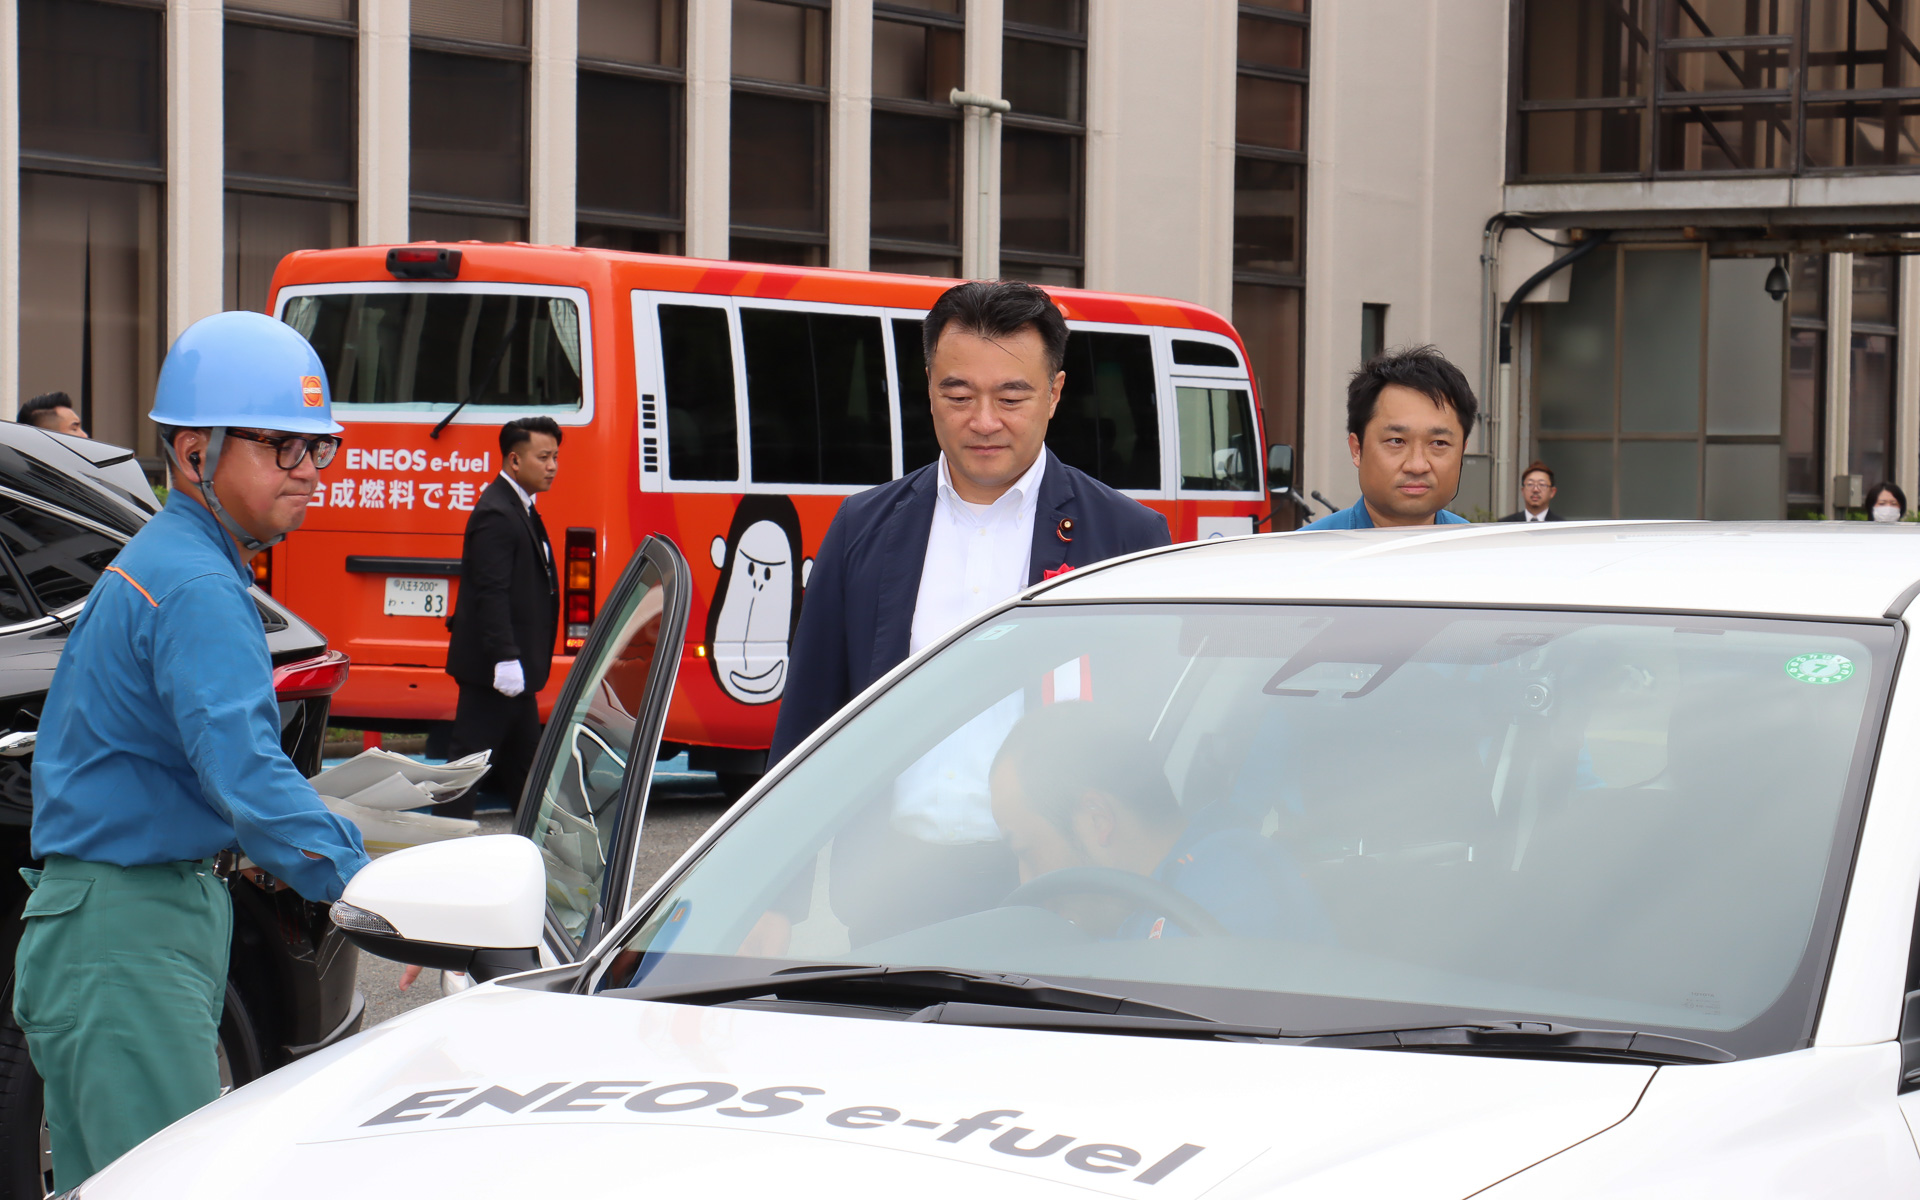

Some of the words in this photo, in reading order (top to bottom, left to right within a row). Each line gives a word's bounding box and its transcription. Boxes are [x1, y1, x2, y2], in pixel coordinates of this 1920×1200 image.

[346, 448, 427, 471] ENEOS
[430, 450, 489, 472] e-fuel
[1811, 663, 1828, 673] 7
[359, 1081, 825, 1128] ENEOS
[826, 1106, 1205, 1185] e-fuel
